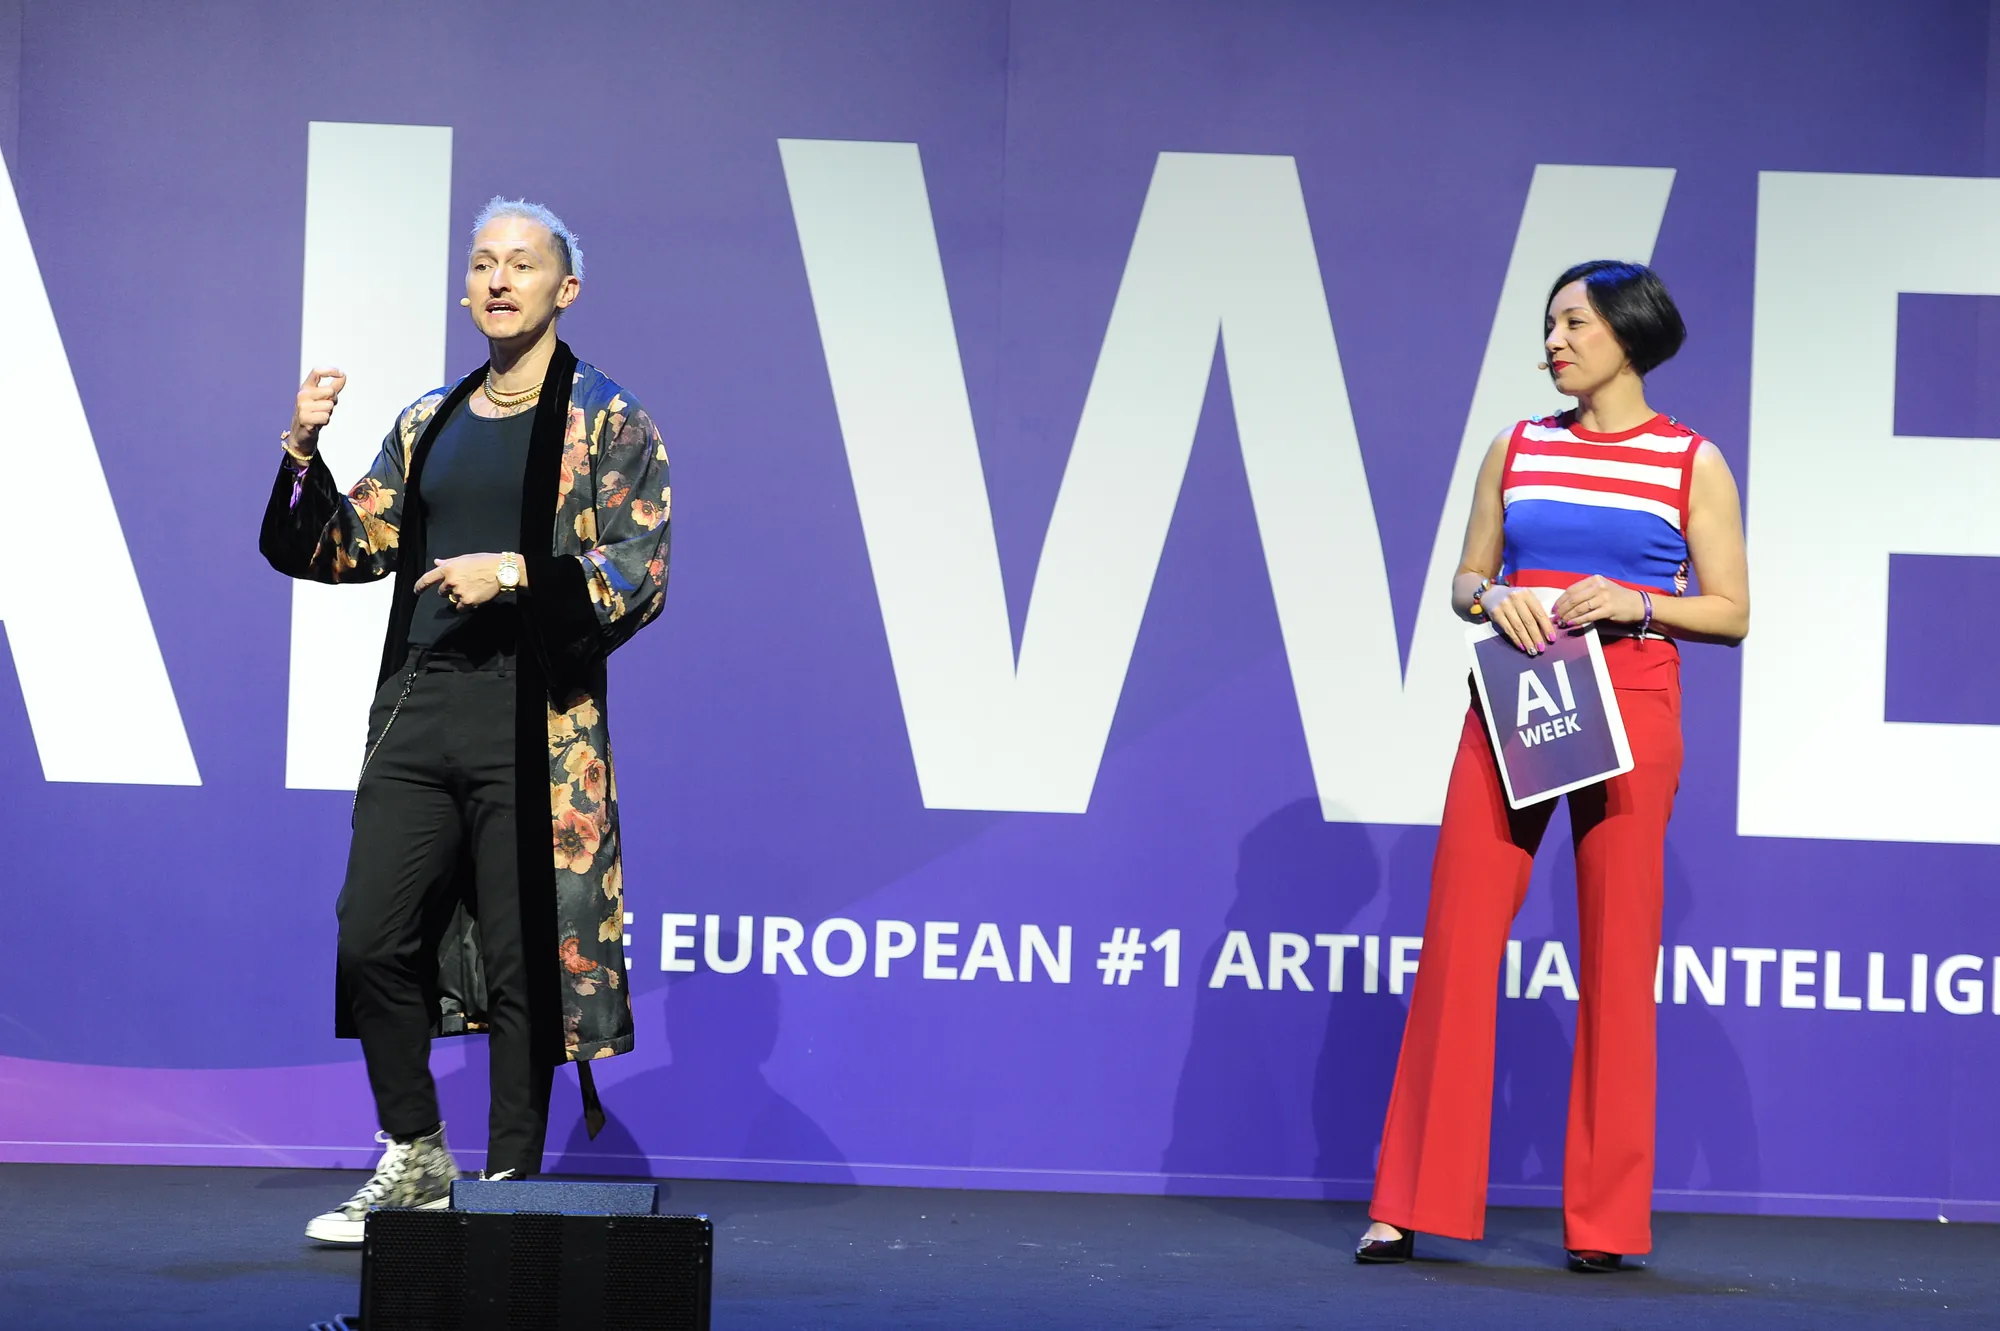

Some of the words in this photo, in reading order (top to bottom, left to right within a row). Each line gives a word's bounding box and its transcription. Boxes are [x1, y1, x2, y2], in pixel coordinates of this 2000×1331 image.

[1516, 659, 1576, 727] AI
[1518, 713, 1582, 748] WEEK
[660, 912, 1073, 984] EUROPEAN
[1096, 927, 1181, 988] #1
[1208, 930, 1581, 1001] ARTIFIA
[1653, 945, 2000, 1016] NTELLIG
